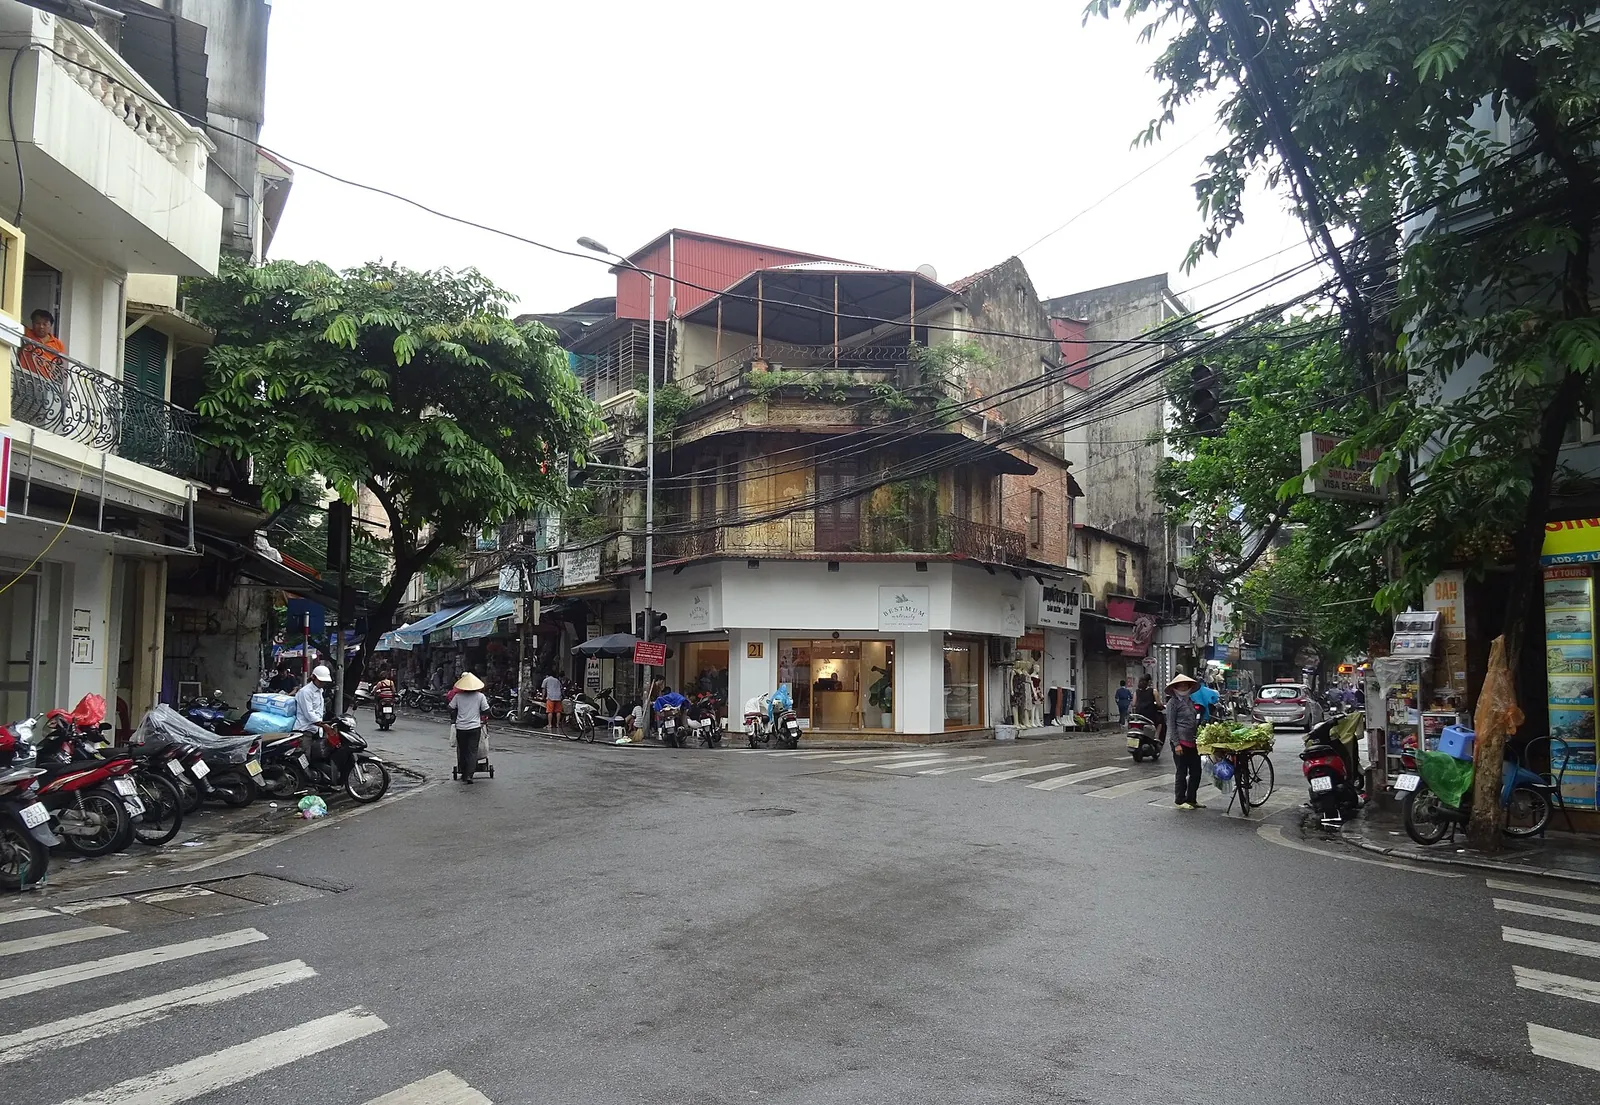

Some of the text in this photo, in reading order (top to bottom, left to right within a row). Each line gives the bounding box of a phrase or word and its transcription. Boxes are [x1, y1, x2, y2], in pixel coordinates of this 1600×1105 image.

[1328, 469, 1342, 478] SIM
[1322, 479, 1381, 495] VISA EXNSION
[1551, 556, 1575, 564] ADD:
[1560, 569, 1587, 578] TOURS
[883, 606, 925, 617] BESTMUM
[749, 644, 762, 657] 21
